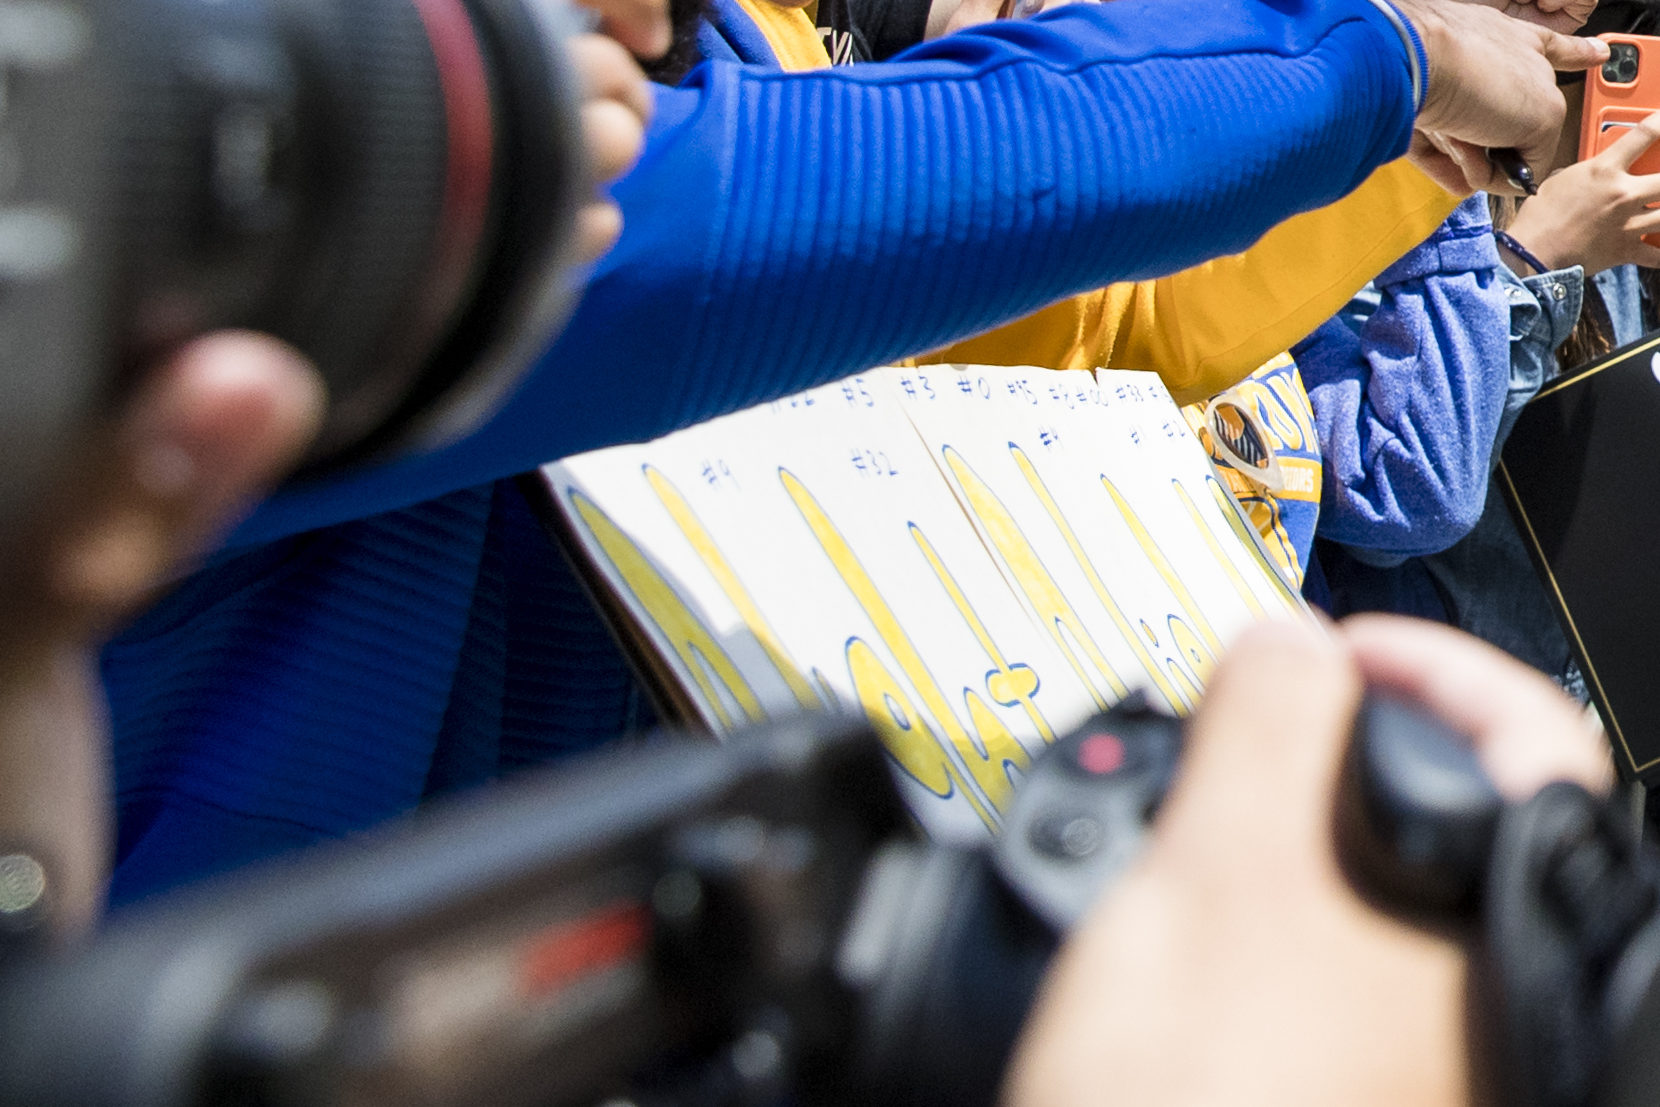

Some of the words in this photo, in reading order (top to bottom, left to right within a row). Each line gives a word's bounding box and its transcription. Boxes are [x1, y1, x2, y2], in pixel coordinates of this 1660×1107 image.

[901, 375, 936, 401] #3
[957, 374, 990, 400] #0
[701, 459, 741, 492] #9
[851, 447, 899, 478] #32
